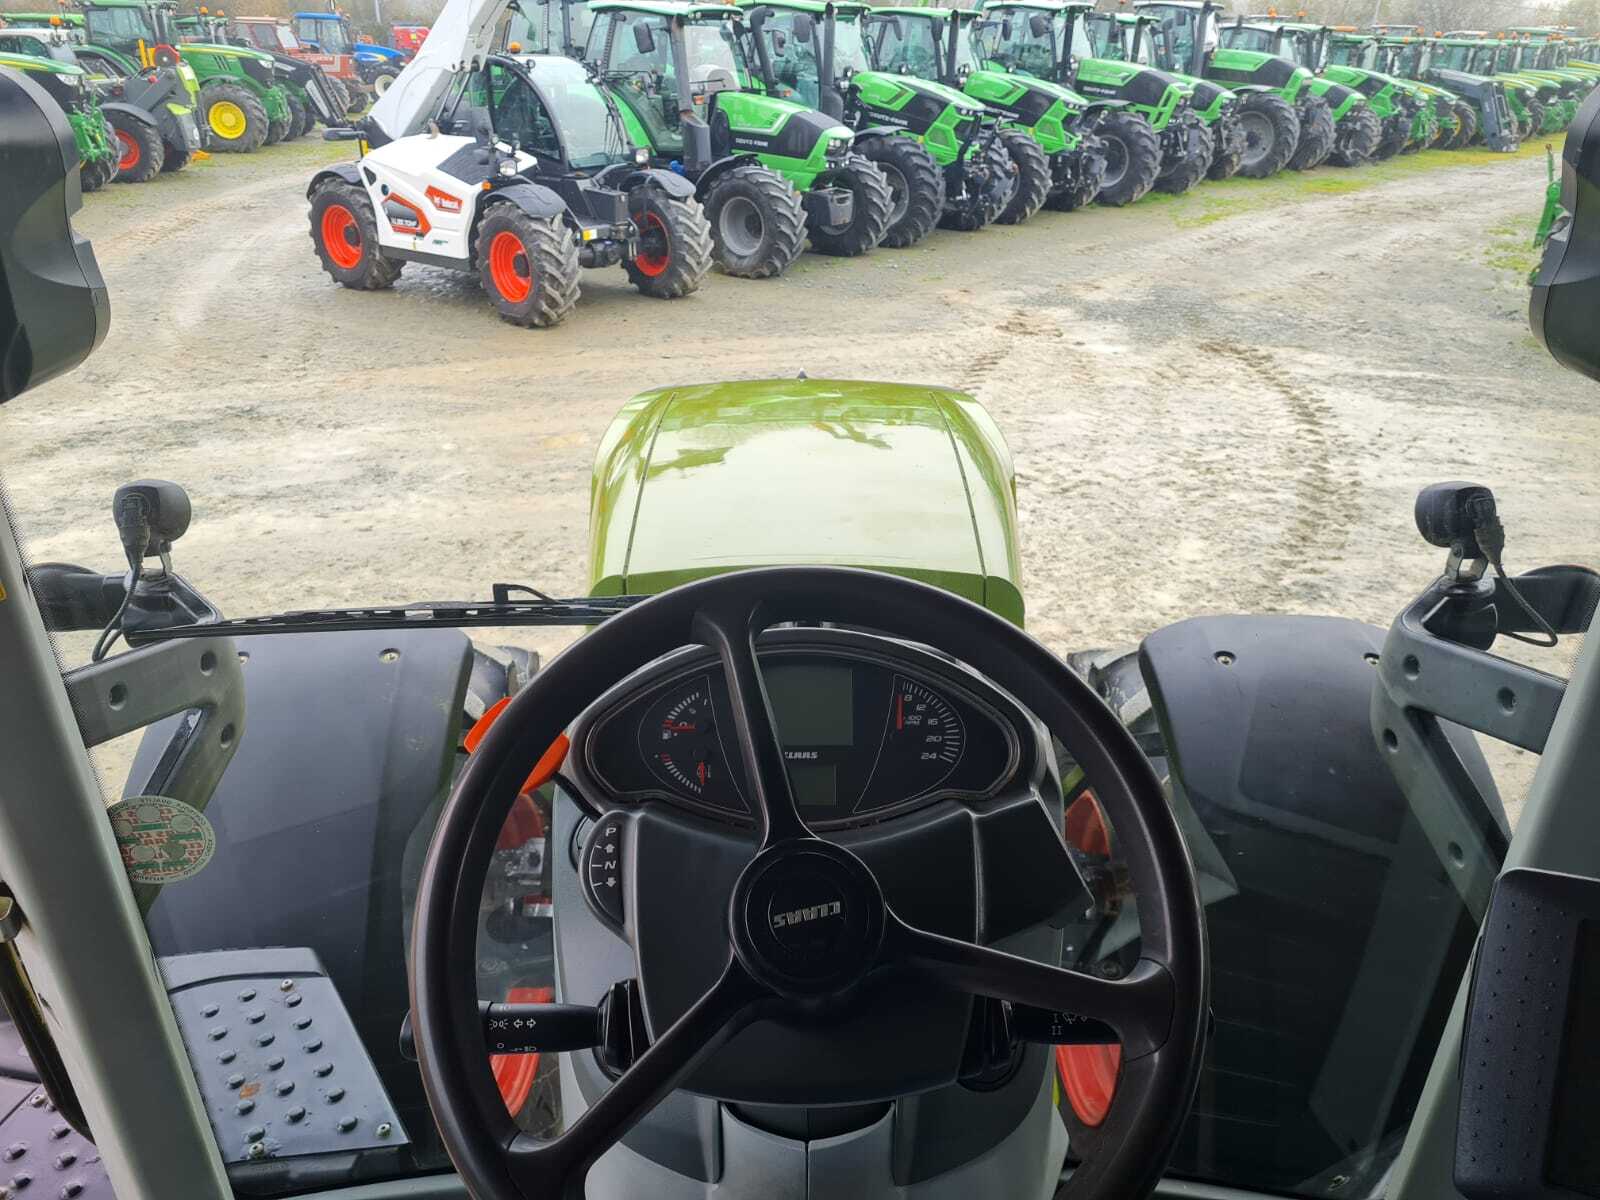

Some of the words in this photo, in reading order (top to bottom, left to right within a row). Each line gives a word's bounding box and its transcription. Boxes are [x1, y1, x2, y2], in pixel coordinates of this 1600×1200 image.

[916, 703, 927, 711] 12
[927, 718, 938, 726] 16
[926, 735, 942, 743] 20
[921, 752, 937, 760] 24
[605, 826, 617, 837] P
[604, 860, 617, 870] N
[773, 900, 841, 929] CLAAS
